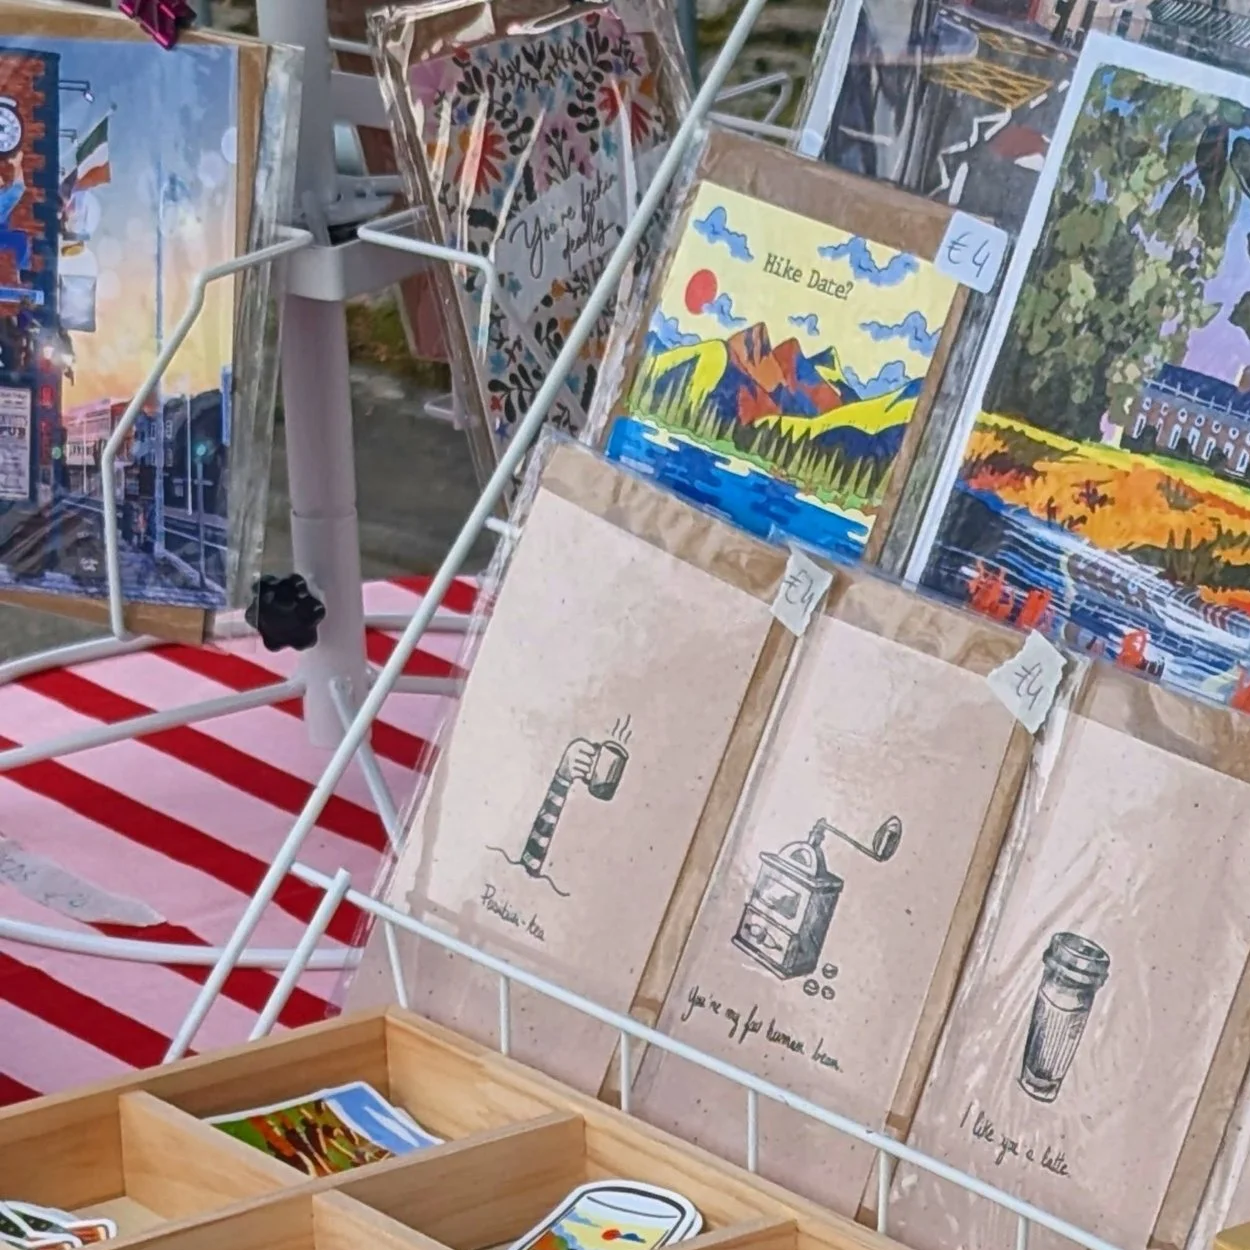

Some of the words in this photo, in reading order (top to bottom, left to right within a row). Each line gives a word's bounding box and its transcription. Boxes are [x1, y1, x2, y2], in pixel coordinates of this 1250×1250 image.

[763, 251, 803, 284] Hike
[806, 268, 855, 301] Date?
[946, 230, 991, 279] €4
[972, 1110, 995, 1143] like
